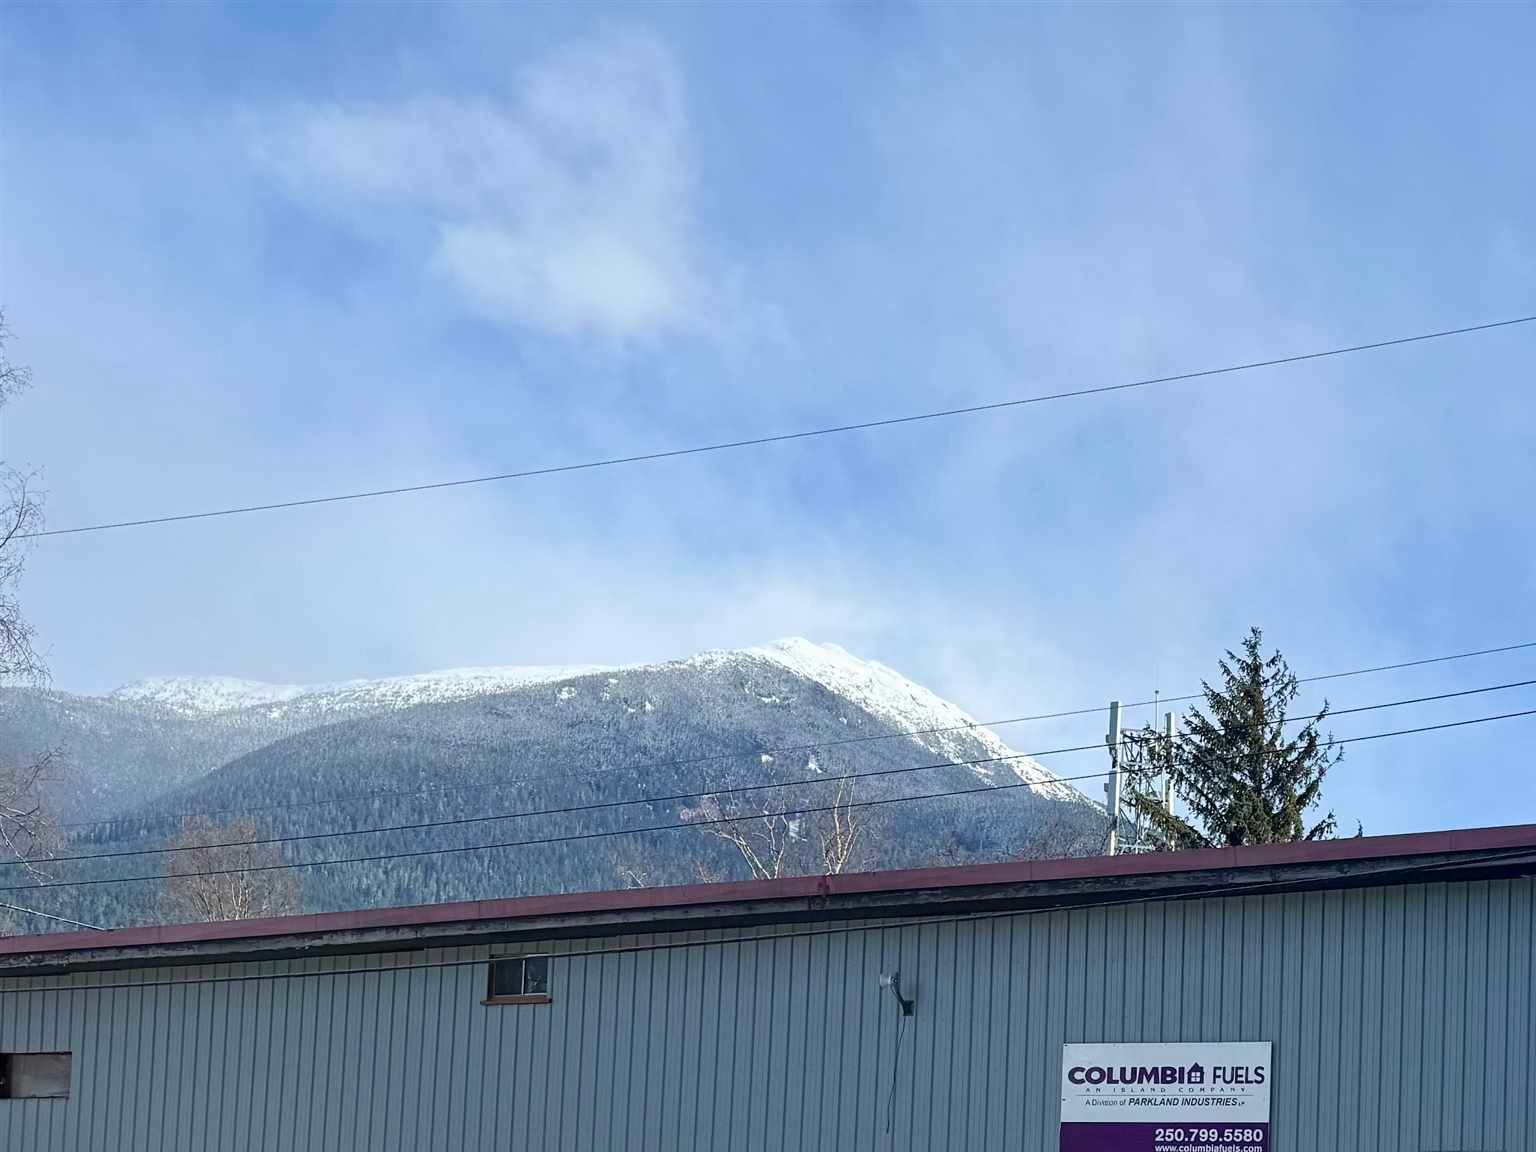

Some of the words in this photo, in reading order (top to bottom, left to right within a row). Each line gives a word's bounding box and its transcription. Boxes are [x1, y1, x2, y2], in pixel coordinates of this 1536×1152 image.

[1213, 1066, 1265, 1085] FUELS
[1128, 1097, 1180, 1106] PARKLAND
[1181, 1097, 1238, 1106] INDUSTRIES
[1155, 1128, 1264, 1142] 250.799.5580
[1154, 1144, 1263, 1152] www.columbiafuels.com
